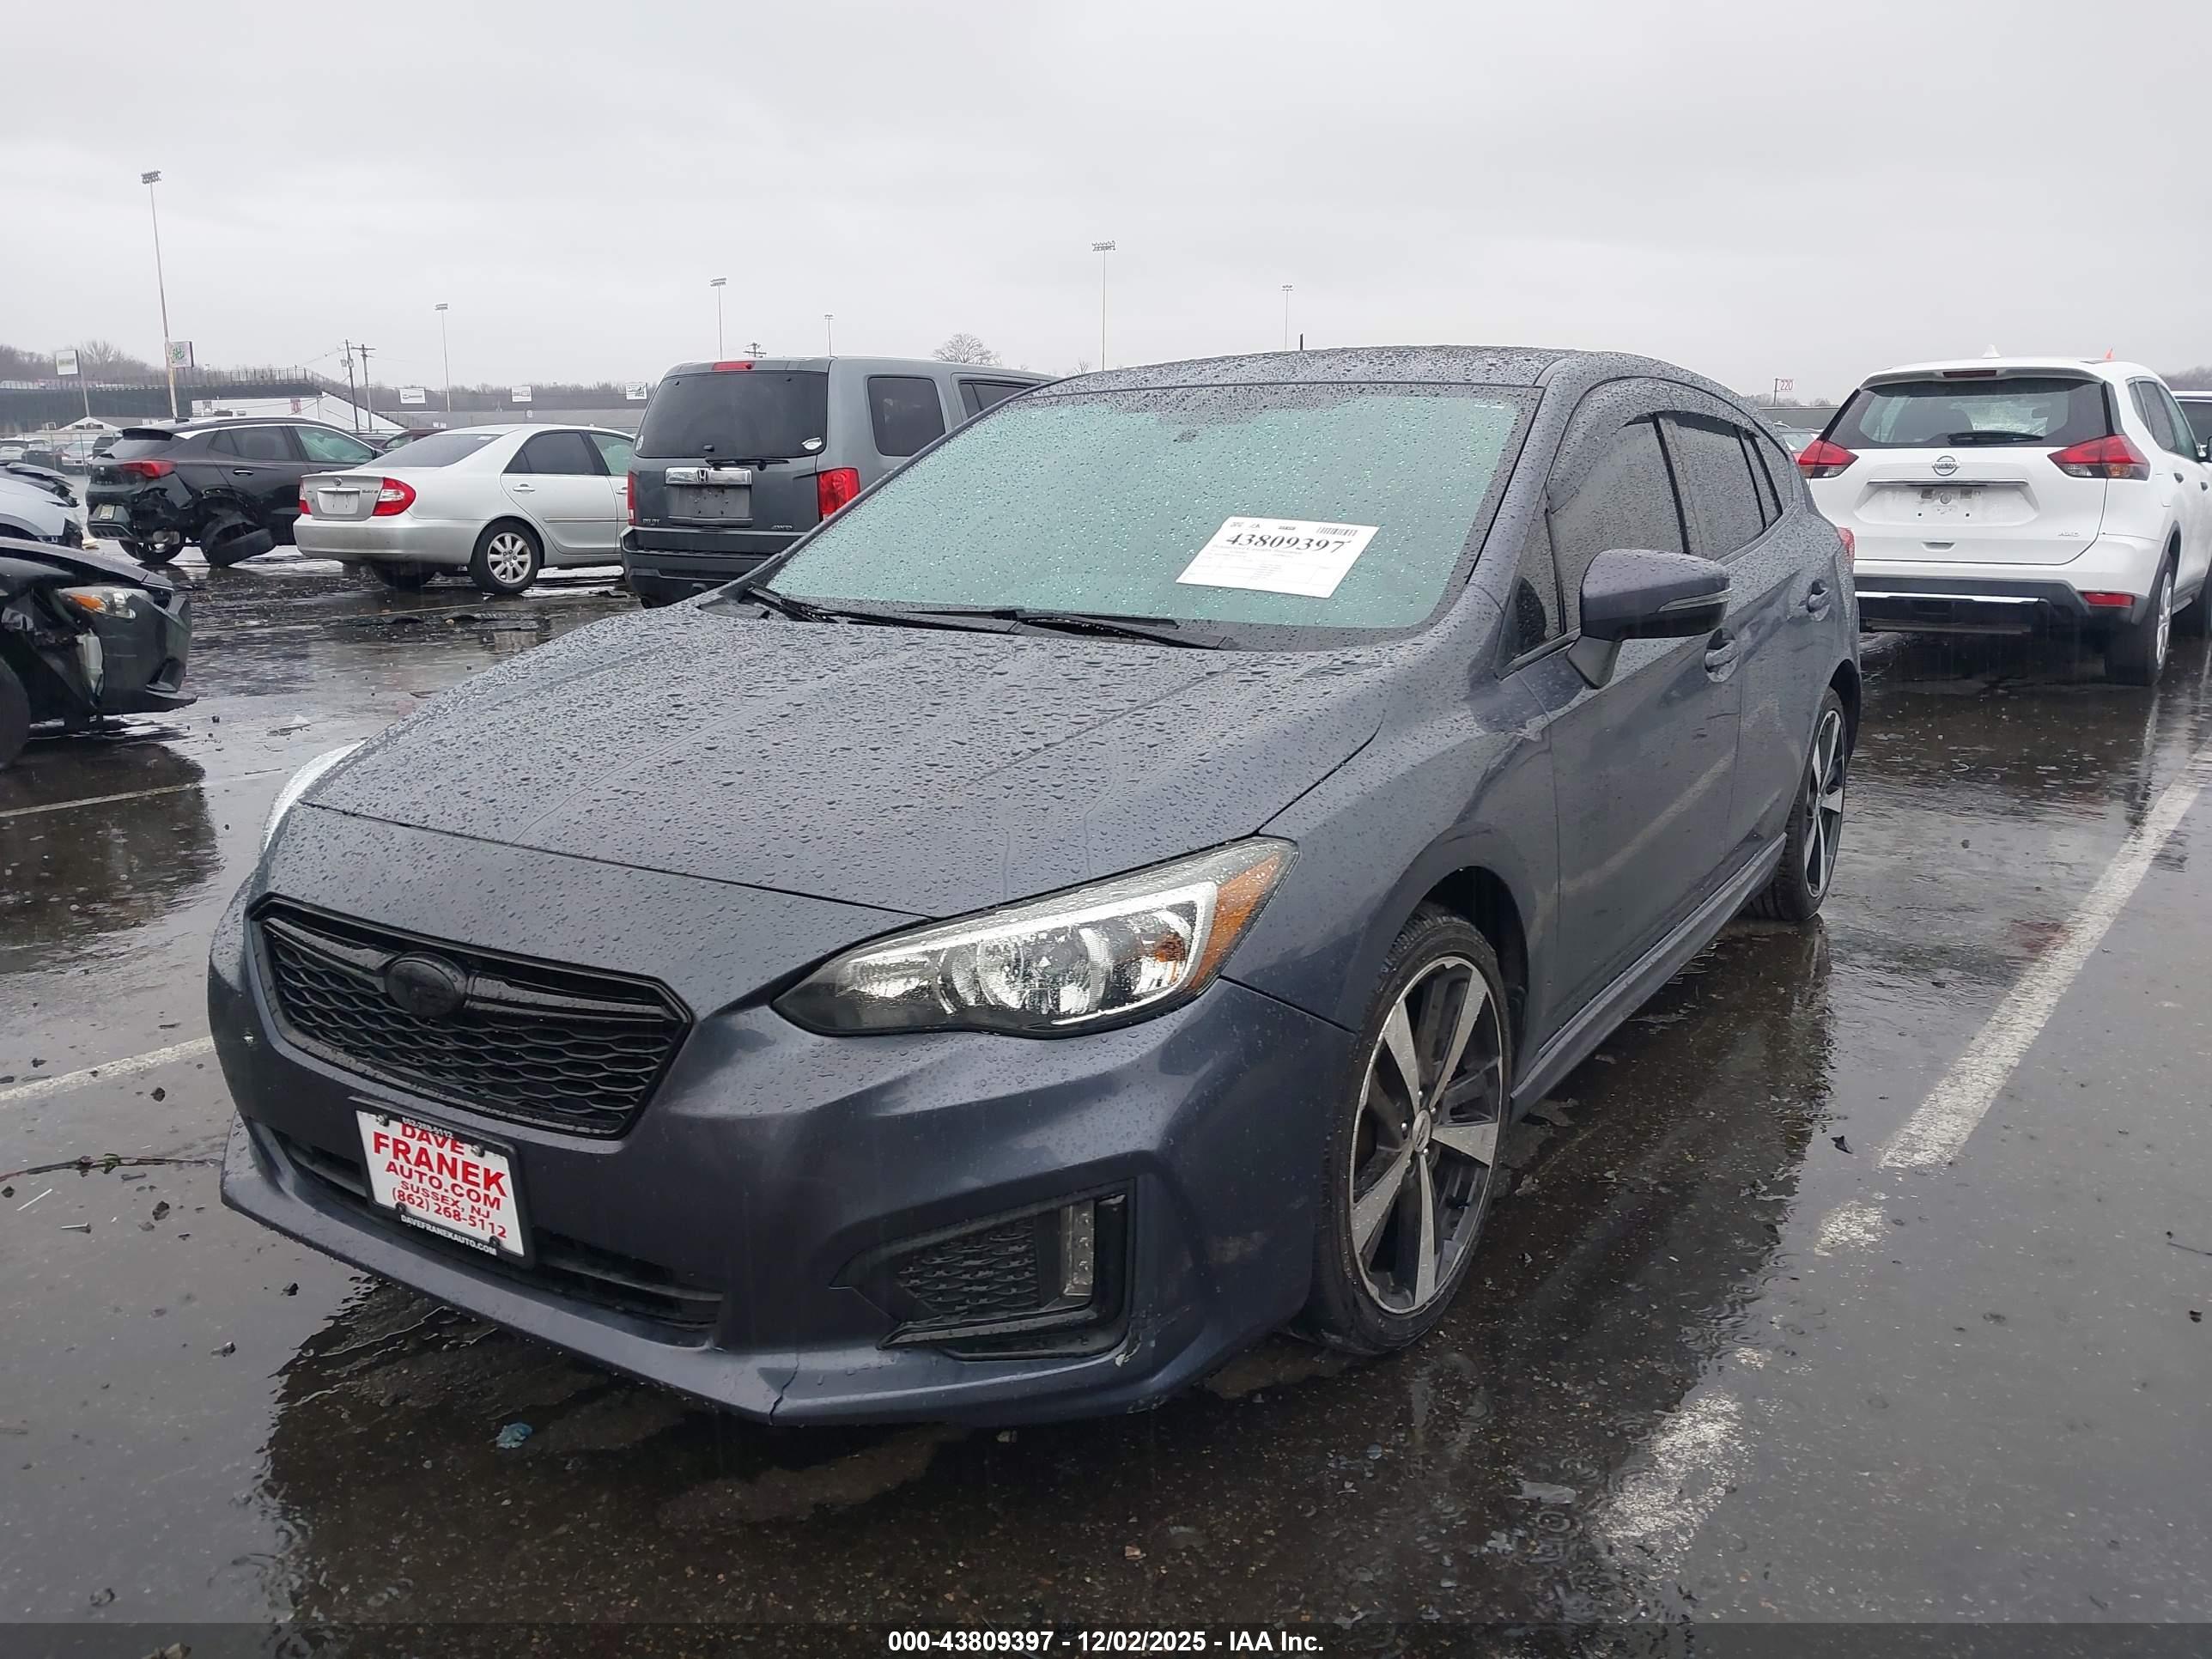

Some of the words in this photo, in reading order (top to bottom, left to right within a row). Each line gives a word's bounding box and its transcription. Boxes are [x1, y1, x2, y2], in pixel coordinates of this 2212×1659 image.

[1780, 380, 1794, 391] 220
[1225, 532, 1352, 554] 43809397
[401, 1124, 465, 1155] DAVE
[374, 1131, 507, 1198] FRANEK
[385, 1161, 501, 1211] AUTO.COM
[400, 1181, 465, 1212] SUSSEX,
[471, 1205, 490, 1218] NJ
[392, 1188, 429, 1212] (862)
[434, 1203, 507, 1238] 268-5112
[400, 1215, 497, 1256] DAVEFRANEKAUTO.COM
